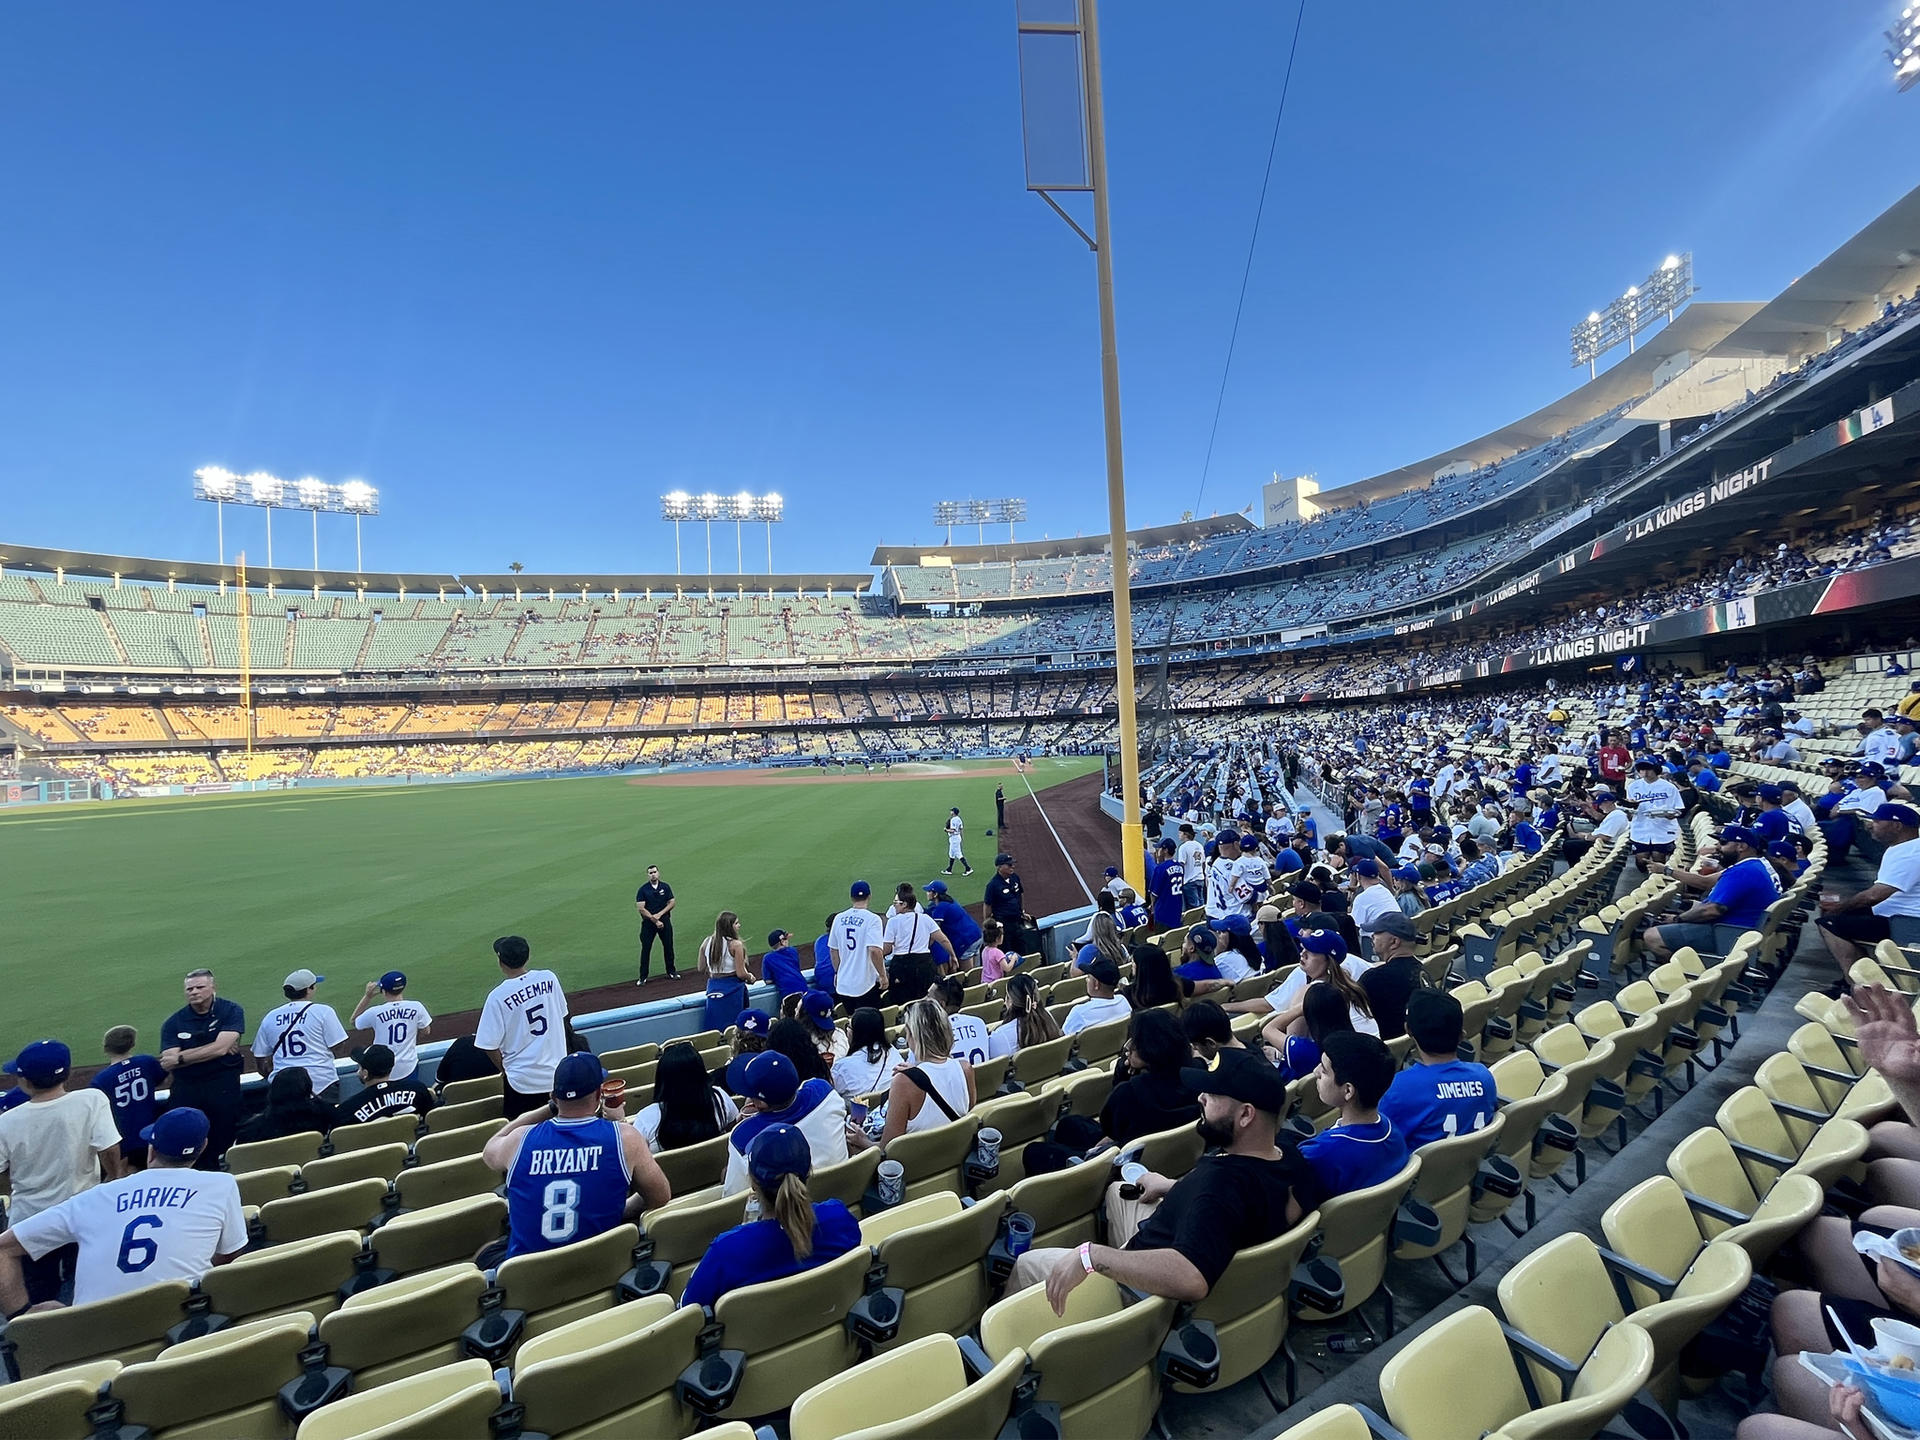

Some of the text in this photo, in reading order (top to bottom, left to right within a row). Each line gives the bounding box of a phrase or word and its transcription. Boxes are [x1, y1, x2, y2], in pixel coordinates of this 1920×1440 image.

[1635, 517, 1654, 539] LA
[1656, 492, 1705, 529] KINGS
[1711, 458, 1773, 504] NIGHT
[1498, 584, 1518, 602] KINGS
[1518, 573, 1540, 592] NIGHT
[1410, 619, 1434, 632] NIGHT
[1537, 625, 1650, 665] LA KINGS NIGHT
[1178, 701, 1210, 709] KINGS
[1212, 699, 1243, 707] NIGHT
[1345, 687, 1368, 698] KINGS
[1369, 685, 1387, 696] NIGHT
[1023, 709, 1056, 717] NIGHT
[1634, 791, 1669, 804] Dodgers
[841, 916, 864, 927] SEAGER
[846, 928, 857, 951] 5
[503, 980, 553, 1010] FREEMAN
[377, 1008, 417, 1024] TURNER
[525, 1003, 548, 1036] 5
[279, 1030, 307, 1058] 16
[388, 1022, 407, 1045] 10
[118, 1067, 141, 1083] BETTS
[114, 1078, 149, 1108] 50
[1436, 1081, 1484, 1099] JIMENES
[353, 1091, 417, 1123] BELLINGER
[529, 1146, 602, 1175] BRYANT
[116, 1186, 198, 1213] GARVEY
[541, 1179, 581, 1243] 8
[116, 1214, 163, 1274] 6
